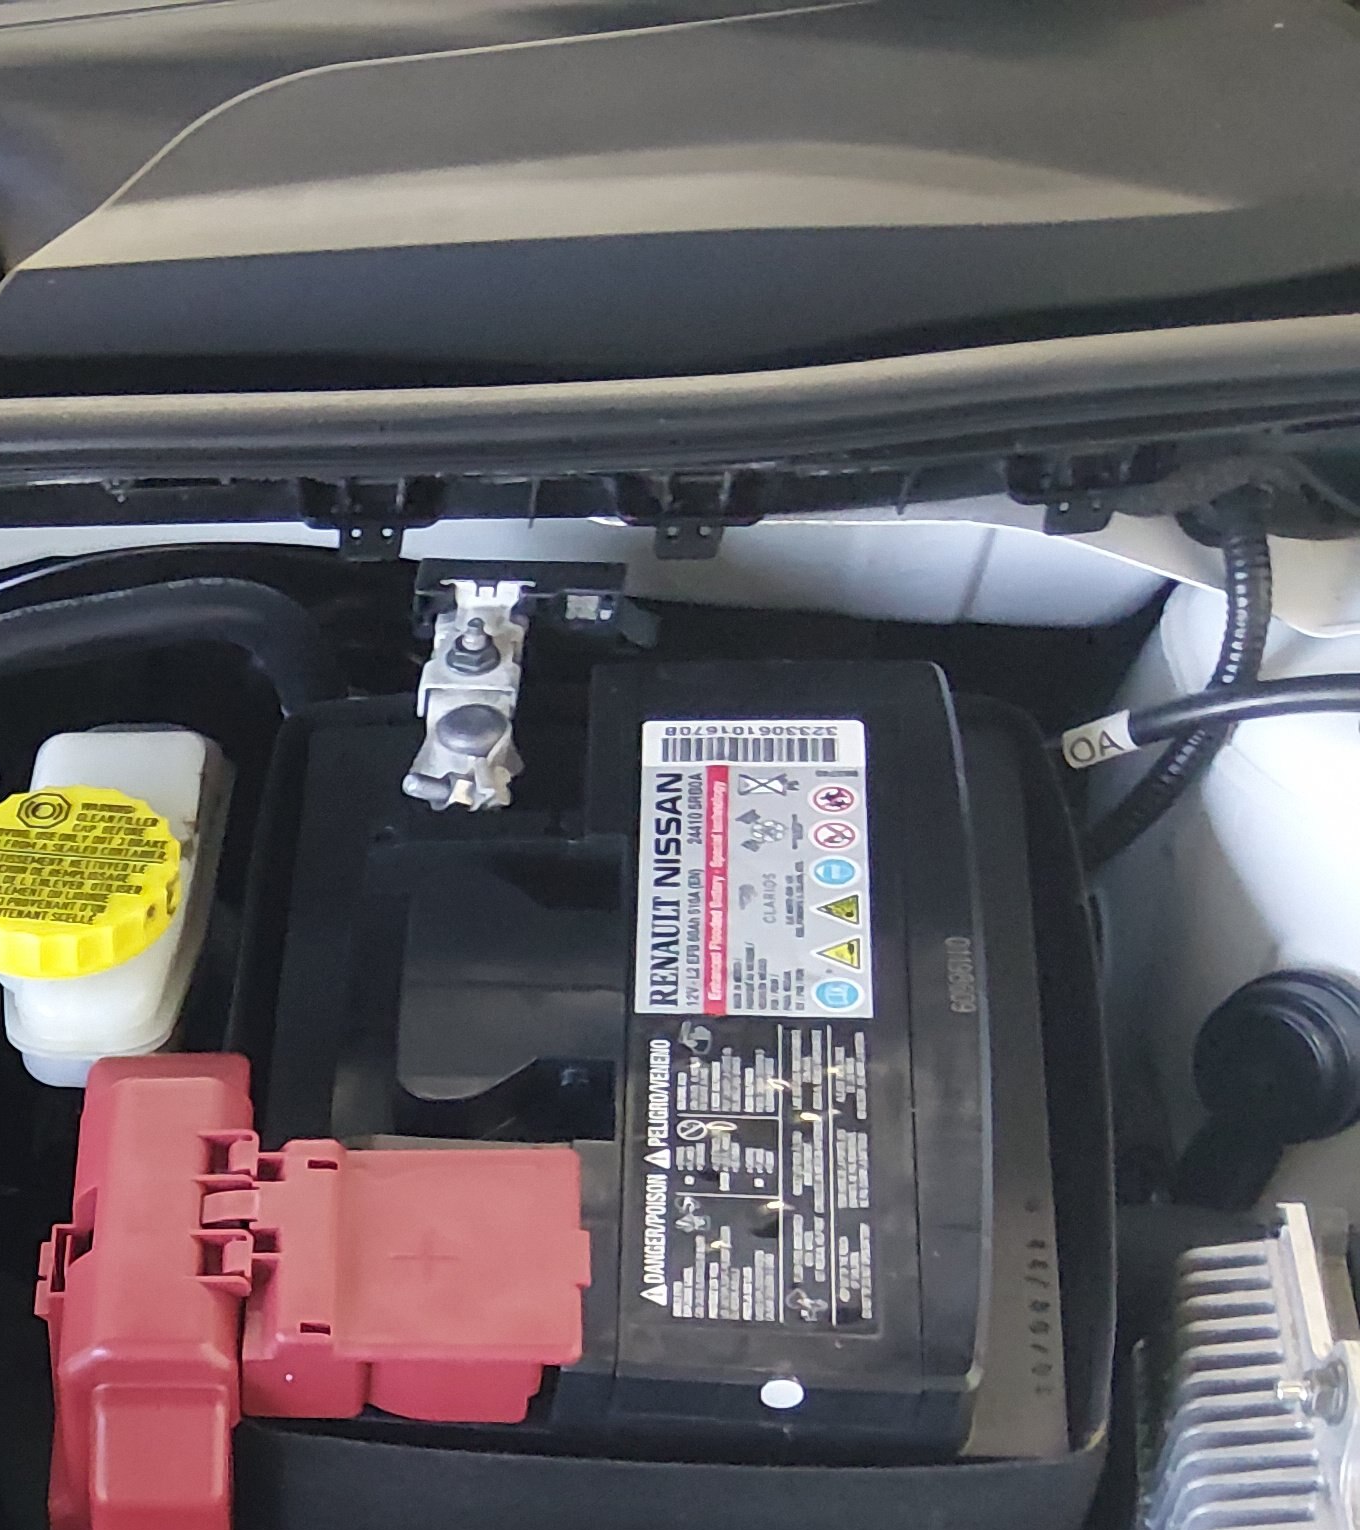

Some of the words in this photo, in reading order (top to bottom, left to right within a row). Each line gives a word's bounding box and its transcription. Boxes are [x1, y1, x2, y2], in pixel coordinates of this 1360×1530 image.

[653, 773, 683, 888] NISSAN
[649, 895, 680, 1007] RENAULT
[762, 873, 777, 924] CLARIOS
[647, 1039, 671, 1147] PELIGRO/VENENO
[643, 1173, 669, 1284] DANGER/POISON
